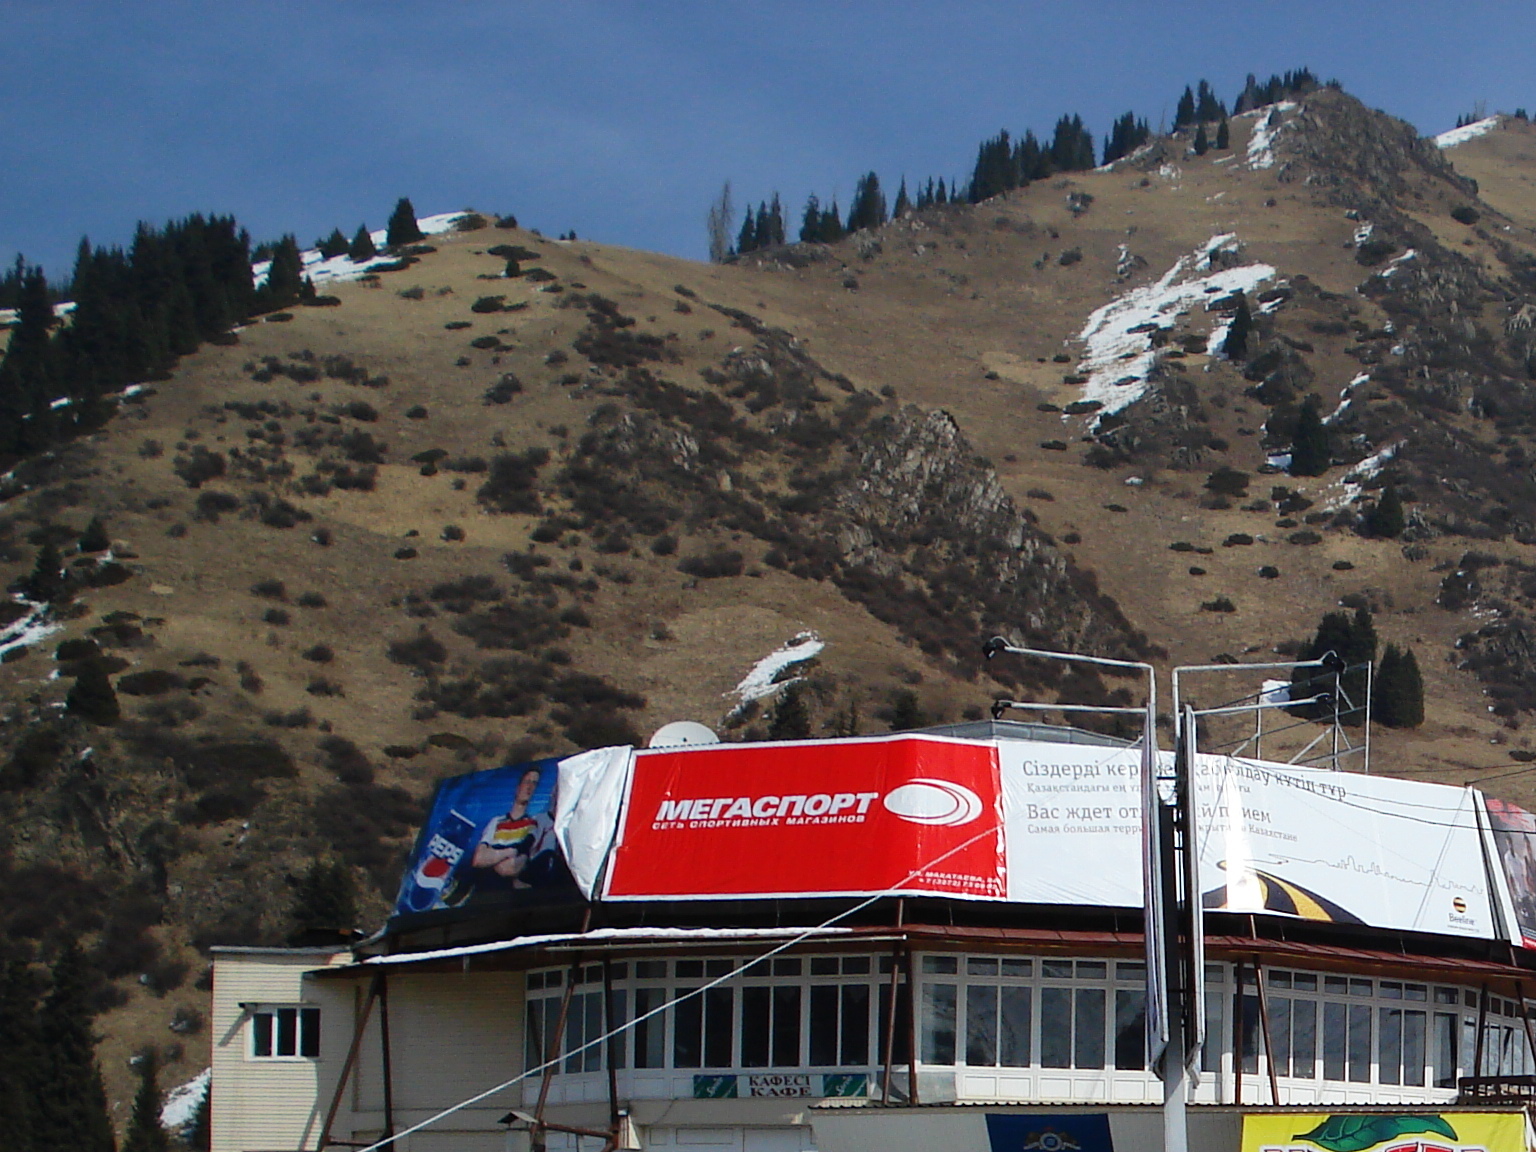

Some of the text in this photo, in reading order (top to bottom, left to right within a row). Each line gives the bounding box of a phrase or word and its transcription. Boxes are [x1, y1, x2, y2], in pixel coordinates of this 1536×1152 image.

[1023, 760, 1101, 779] Сіздерді
[655, 792, 879, 821] МЕГАСПОРТ
[1026, 804, 1060, 819] Вас
[1066, 806, 1112, 821] ждет
[652, 814, 865, 830] СЕТЬ СПОРТИВНЫХ МАГАЗИНОВ
[1027, 824, 1061, 834] Самая
[1063, 824, 1111, 834] большая
[750, 1075, 810, 1086] КАФЕСІ
[751, 1087, 812, 1097] КАФЕ
